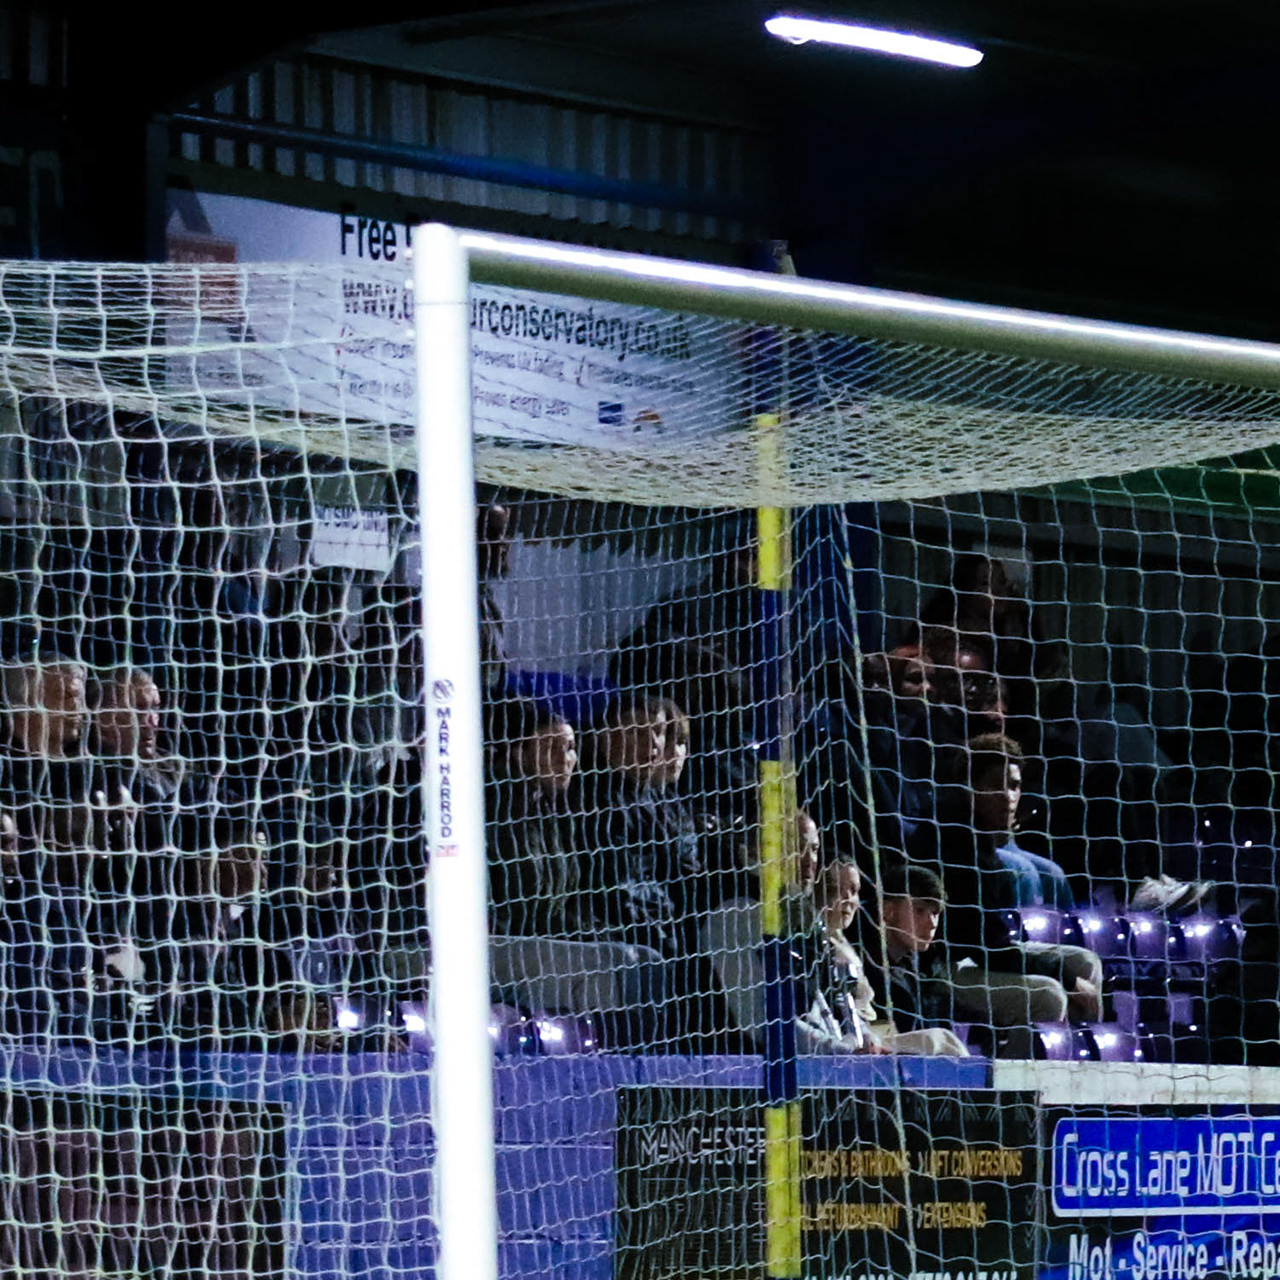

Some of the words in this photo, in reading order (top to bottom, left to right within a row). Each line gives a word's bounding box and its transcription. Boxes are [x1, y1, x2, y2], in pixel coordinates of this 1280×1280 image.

[341, 209, 396, 261] Free
[437, 707, 452, 756] MARK
[440, 763, 453, 839] HARROD
[1062, 1133, 1130, 1197] Cross
[1135, 1134, 1190, 1197] Lane
[1198, 1132, 1255, 1195] MOT
